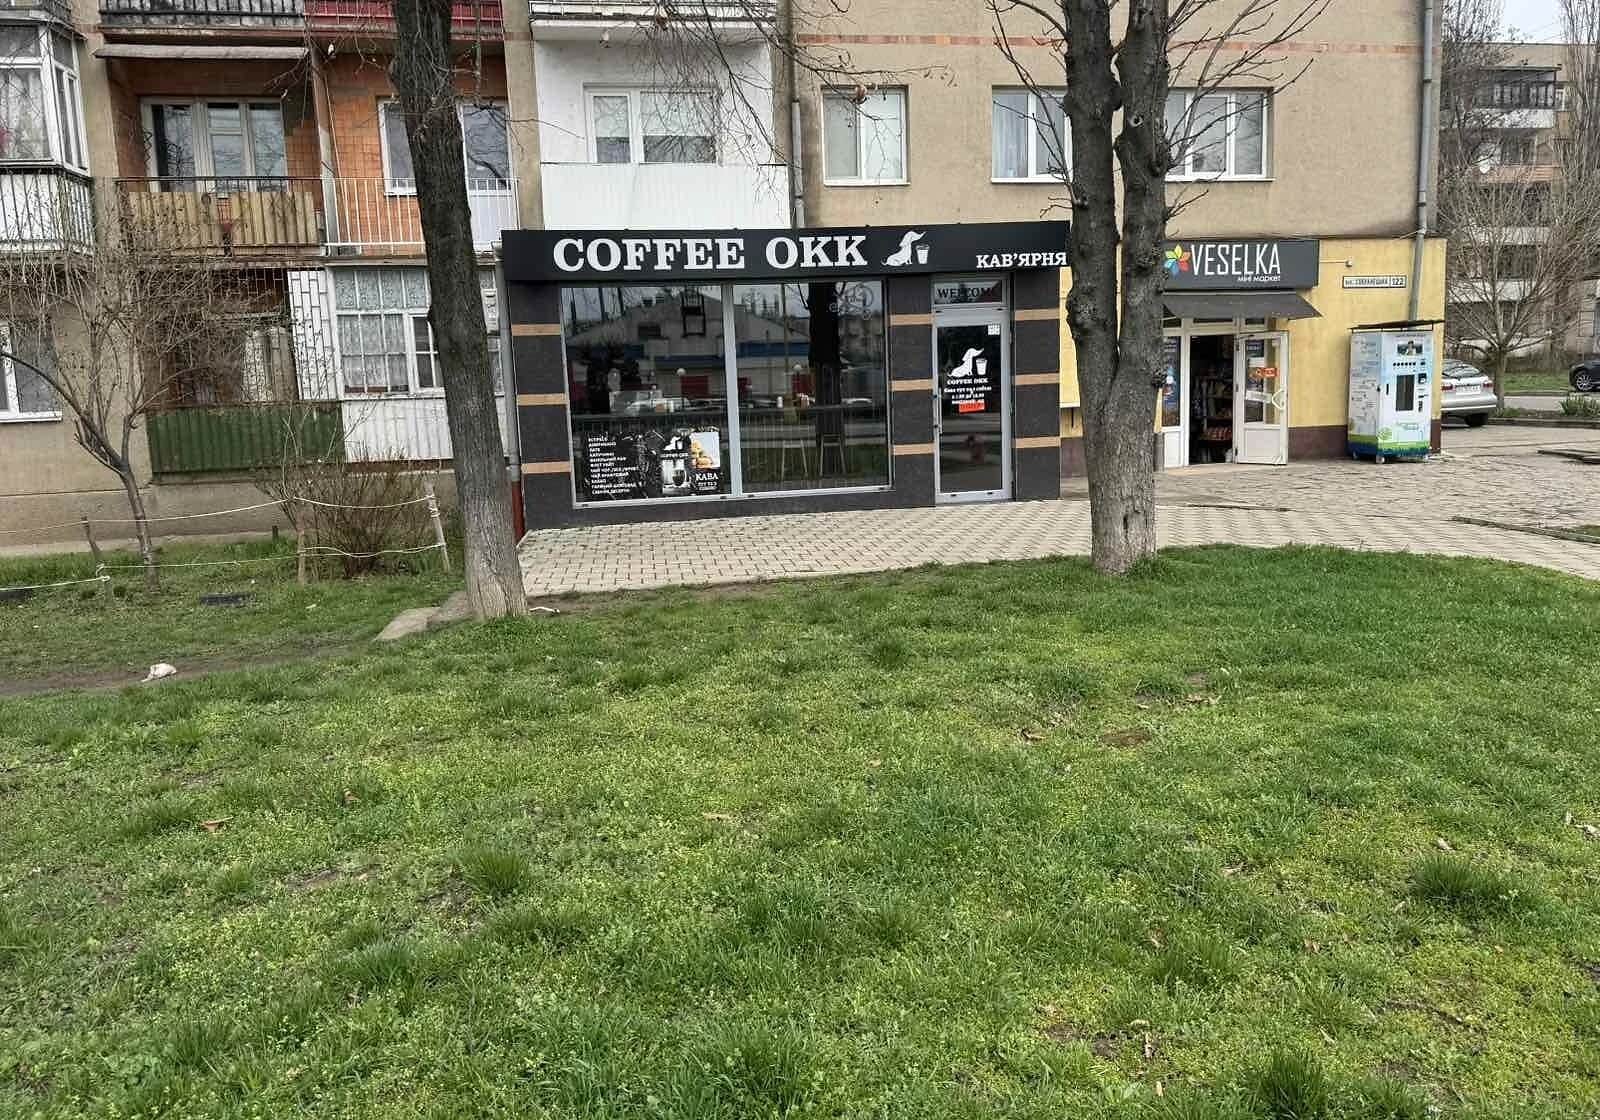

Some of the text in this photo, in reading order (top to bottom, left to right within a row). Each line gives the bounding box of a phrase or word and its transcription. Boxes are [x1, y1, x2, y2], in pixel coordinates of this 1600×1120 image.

[553, 235, 868, 272] COFFEE OKK
[976, 252, 1067, 269] КАВ'ЯРНЯ
[1191, 243, 1281, 276] VESELKA
